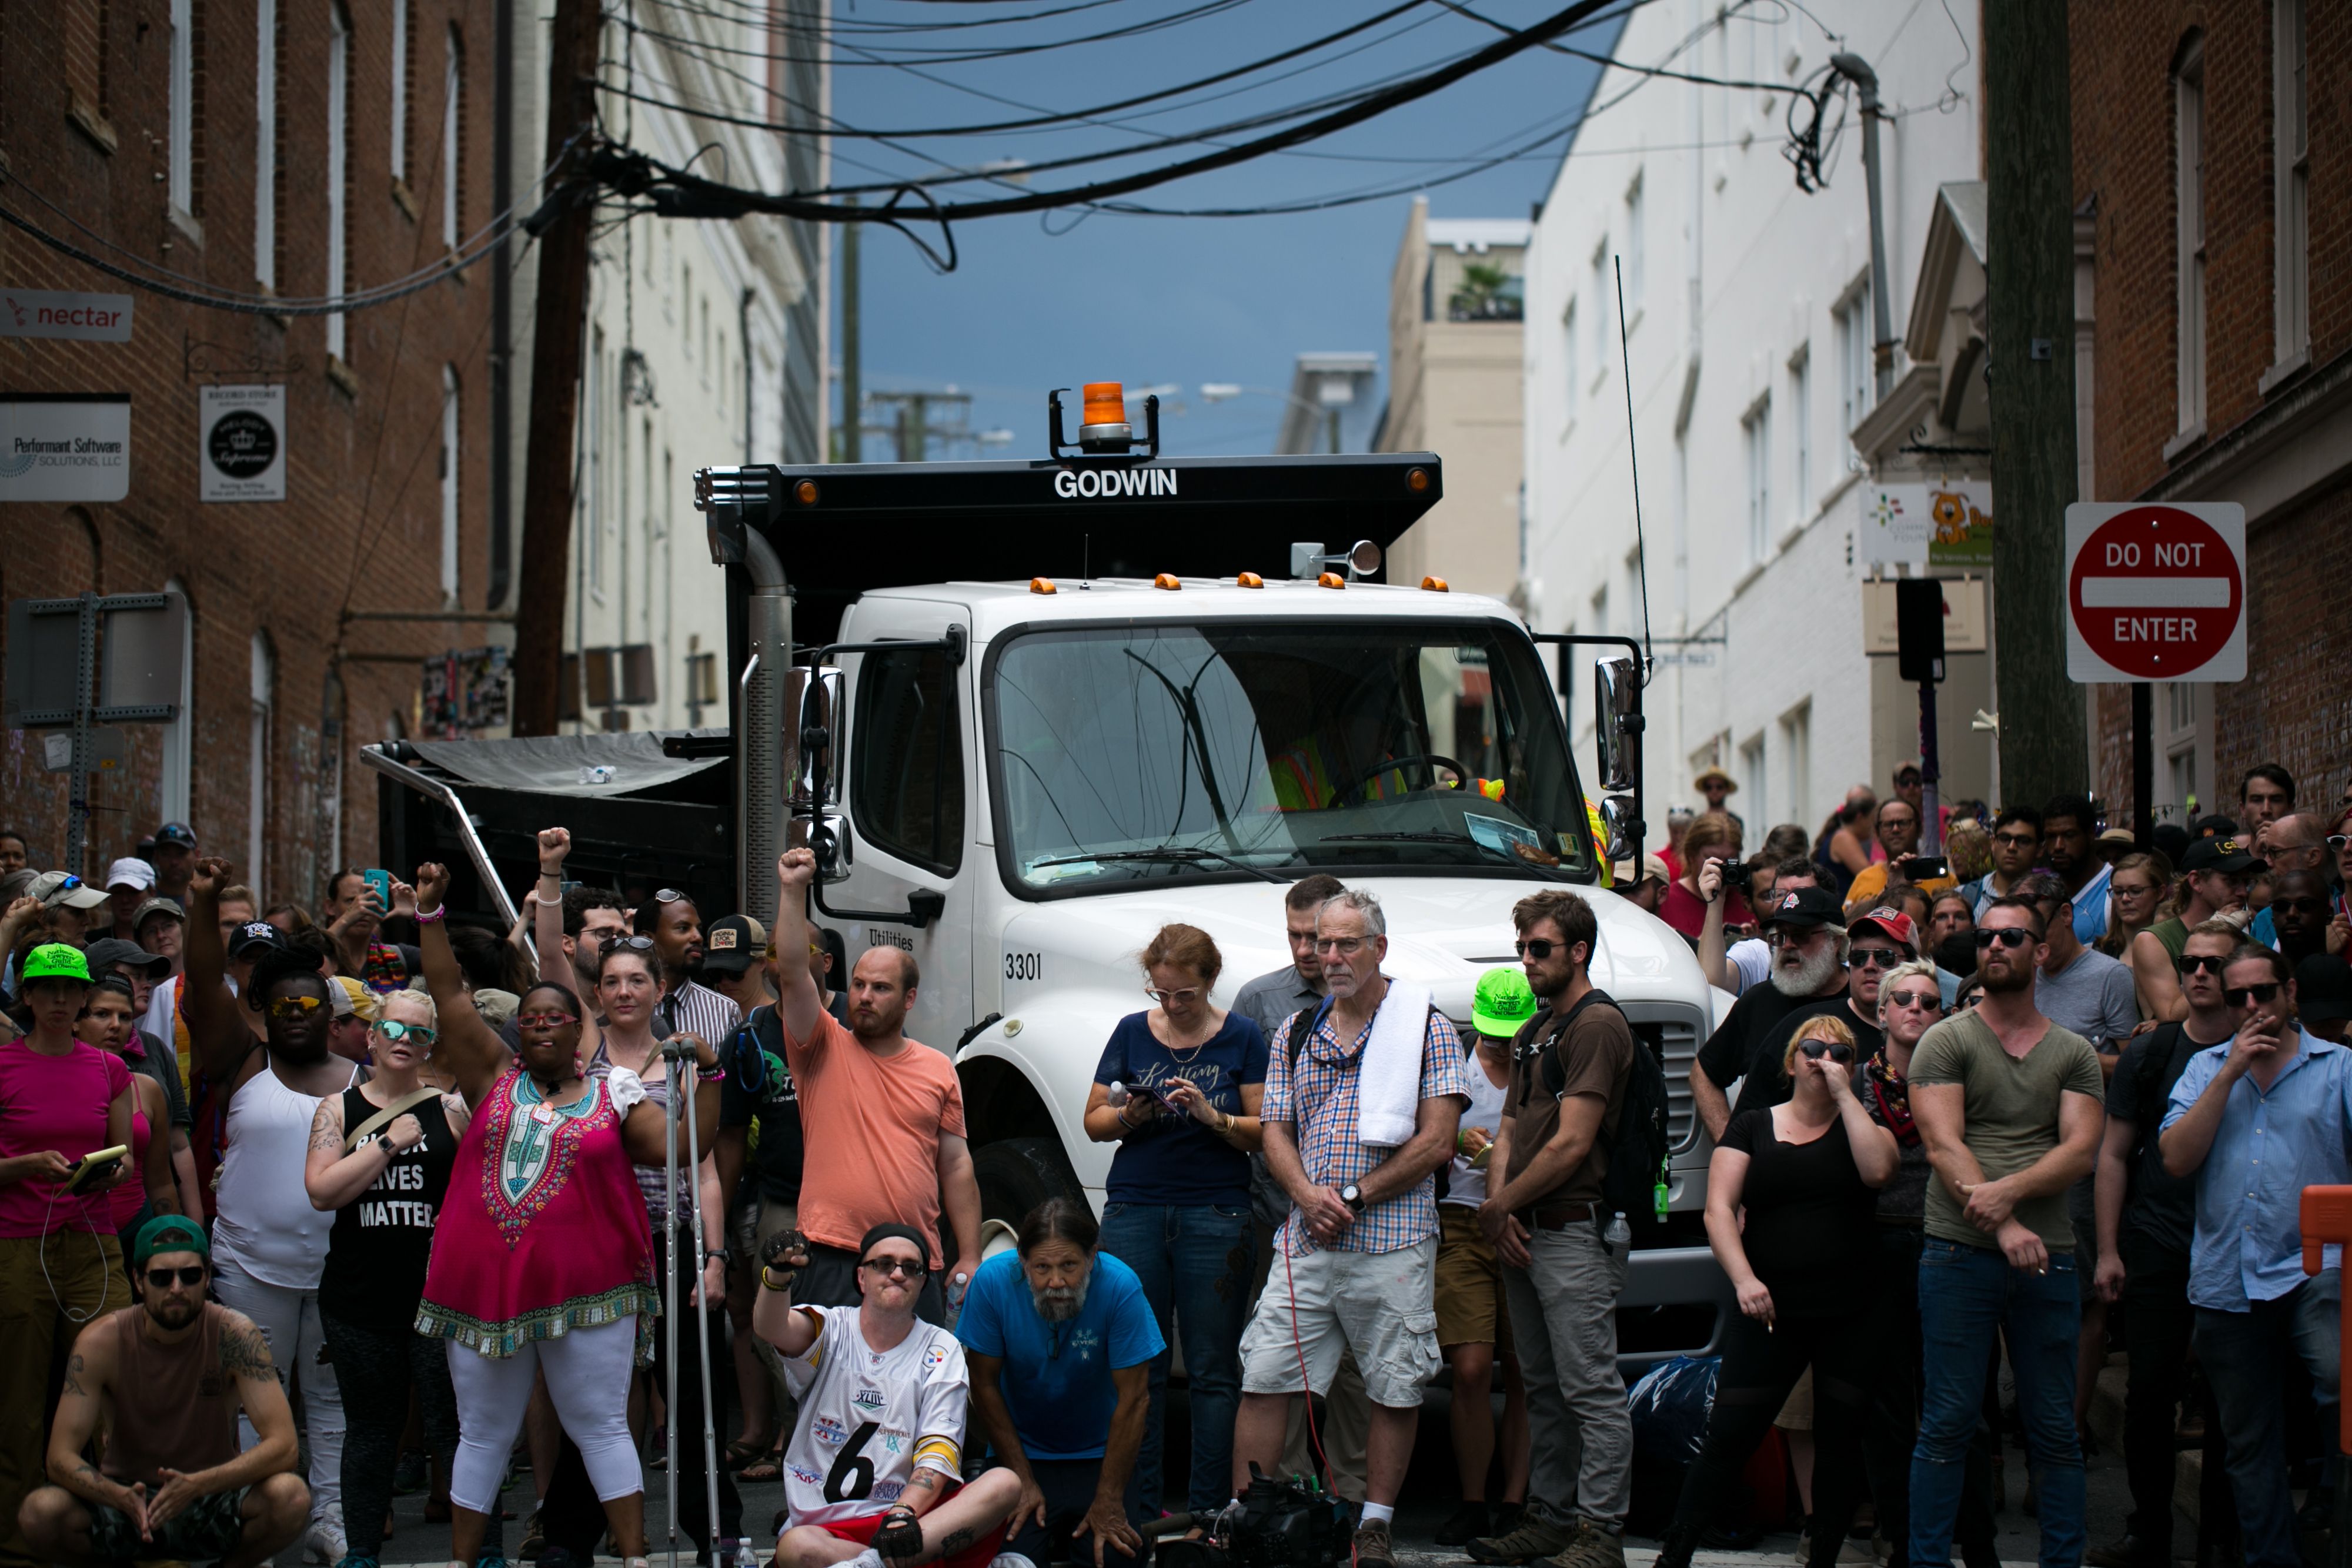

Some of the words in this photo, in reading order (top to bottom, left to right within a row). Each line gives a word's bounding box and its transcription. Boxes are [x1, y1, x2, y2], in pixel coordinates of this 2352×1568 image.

[38, 306, 122, 327] nectar
[14, 437, 71, 453] Performant
[75, 437, 122, 453] Software
[39, 456, 100, 467] SOLUTIONS,
[102, 456, 121, 466] LLC
[1054, 469, 1177, 497] GODWIN
[2105, 543, 2141, 567] DO
[2154, 543, 2205, 567] NOT
[2114, 617, 2197, 642] ENTER
[869, 928, 913, 951] Utilities
[1005, 952, 1041, 981] 3301
[1136, 1062, 1221, 1092] Kntting
[359, 1200, 435, 1228] MATTER
[857, 1392, 881, 1406] XLIII
[877, 1428, 897, 1436] SUPER
[897, 1430, 911, 1439] BOWL
[823, 1421, 881, 1504] 6
[874, 1490, 894, 1499] BOWL
[876, 1483, 896, 1492] SUPER
